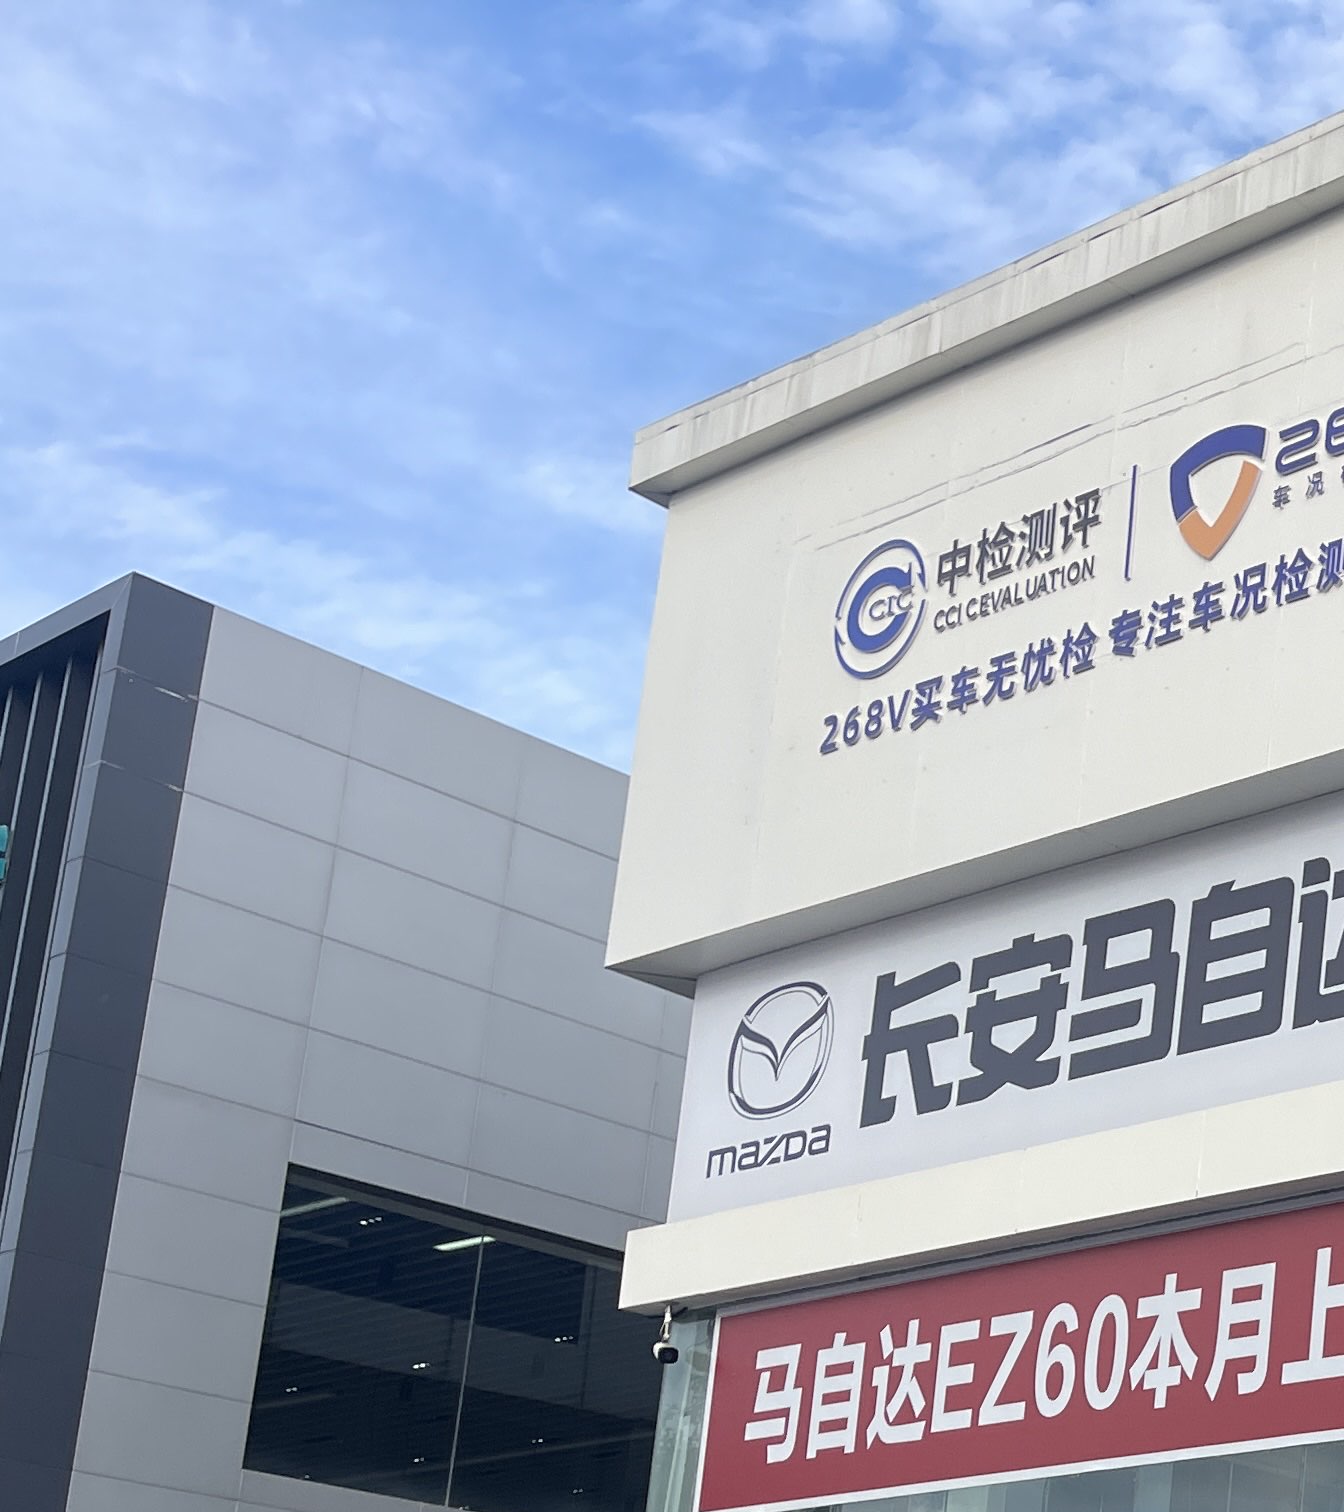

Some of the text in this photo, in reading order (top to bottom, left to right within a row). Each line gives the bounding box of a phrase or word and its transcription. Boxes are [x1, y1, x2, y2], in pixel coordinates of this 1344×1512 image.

[934, 486, 1104, 597] 中检测评
[818, 620, 1098, 756] 268V买车无忧检
[705, 1122, 832, 1180] mazda
